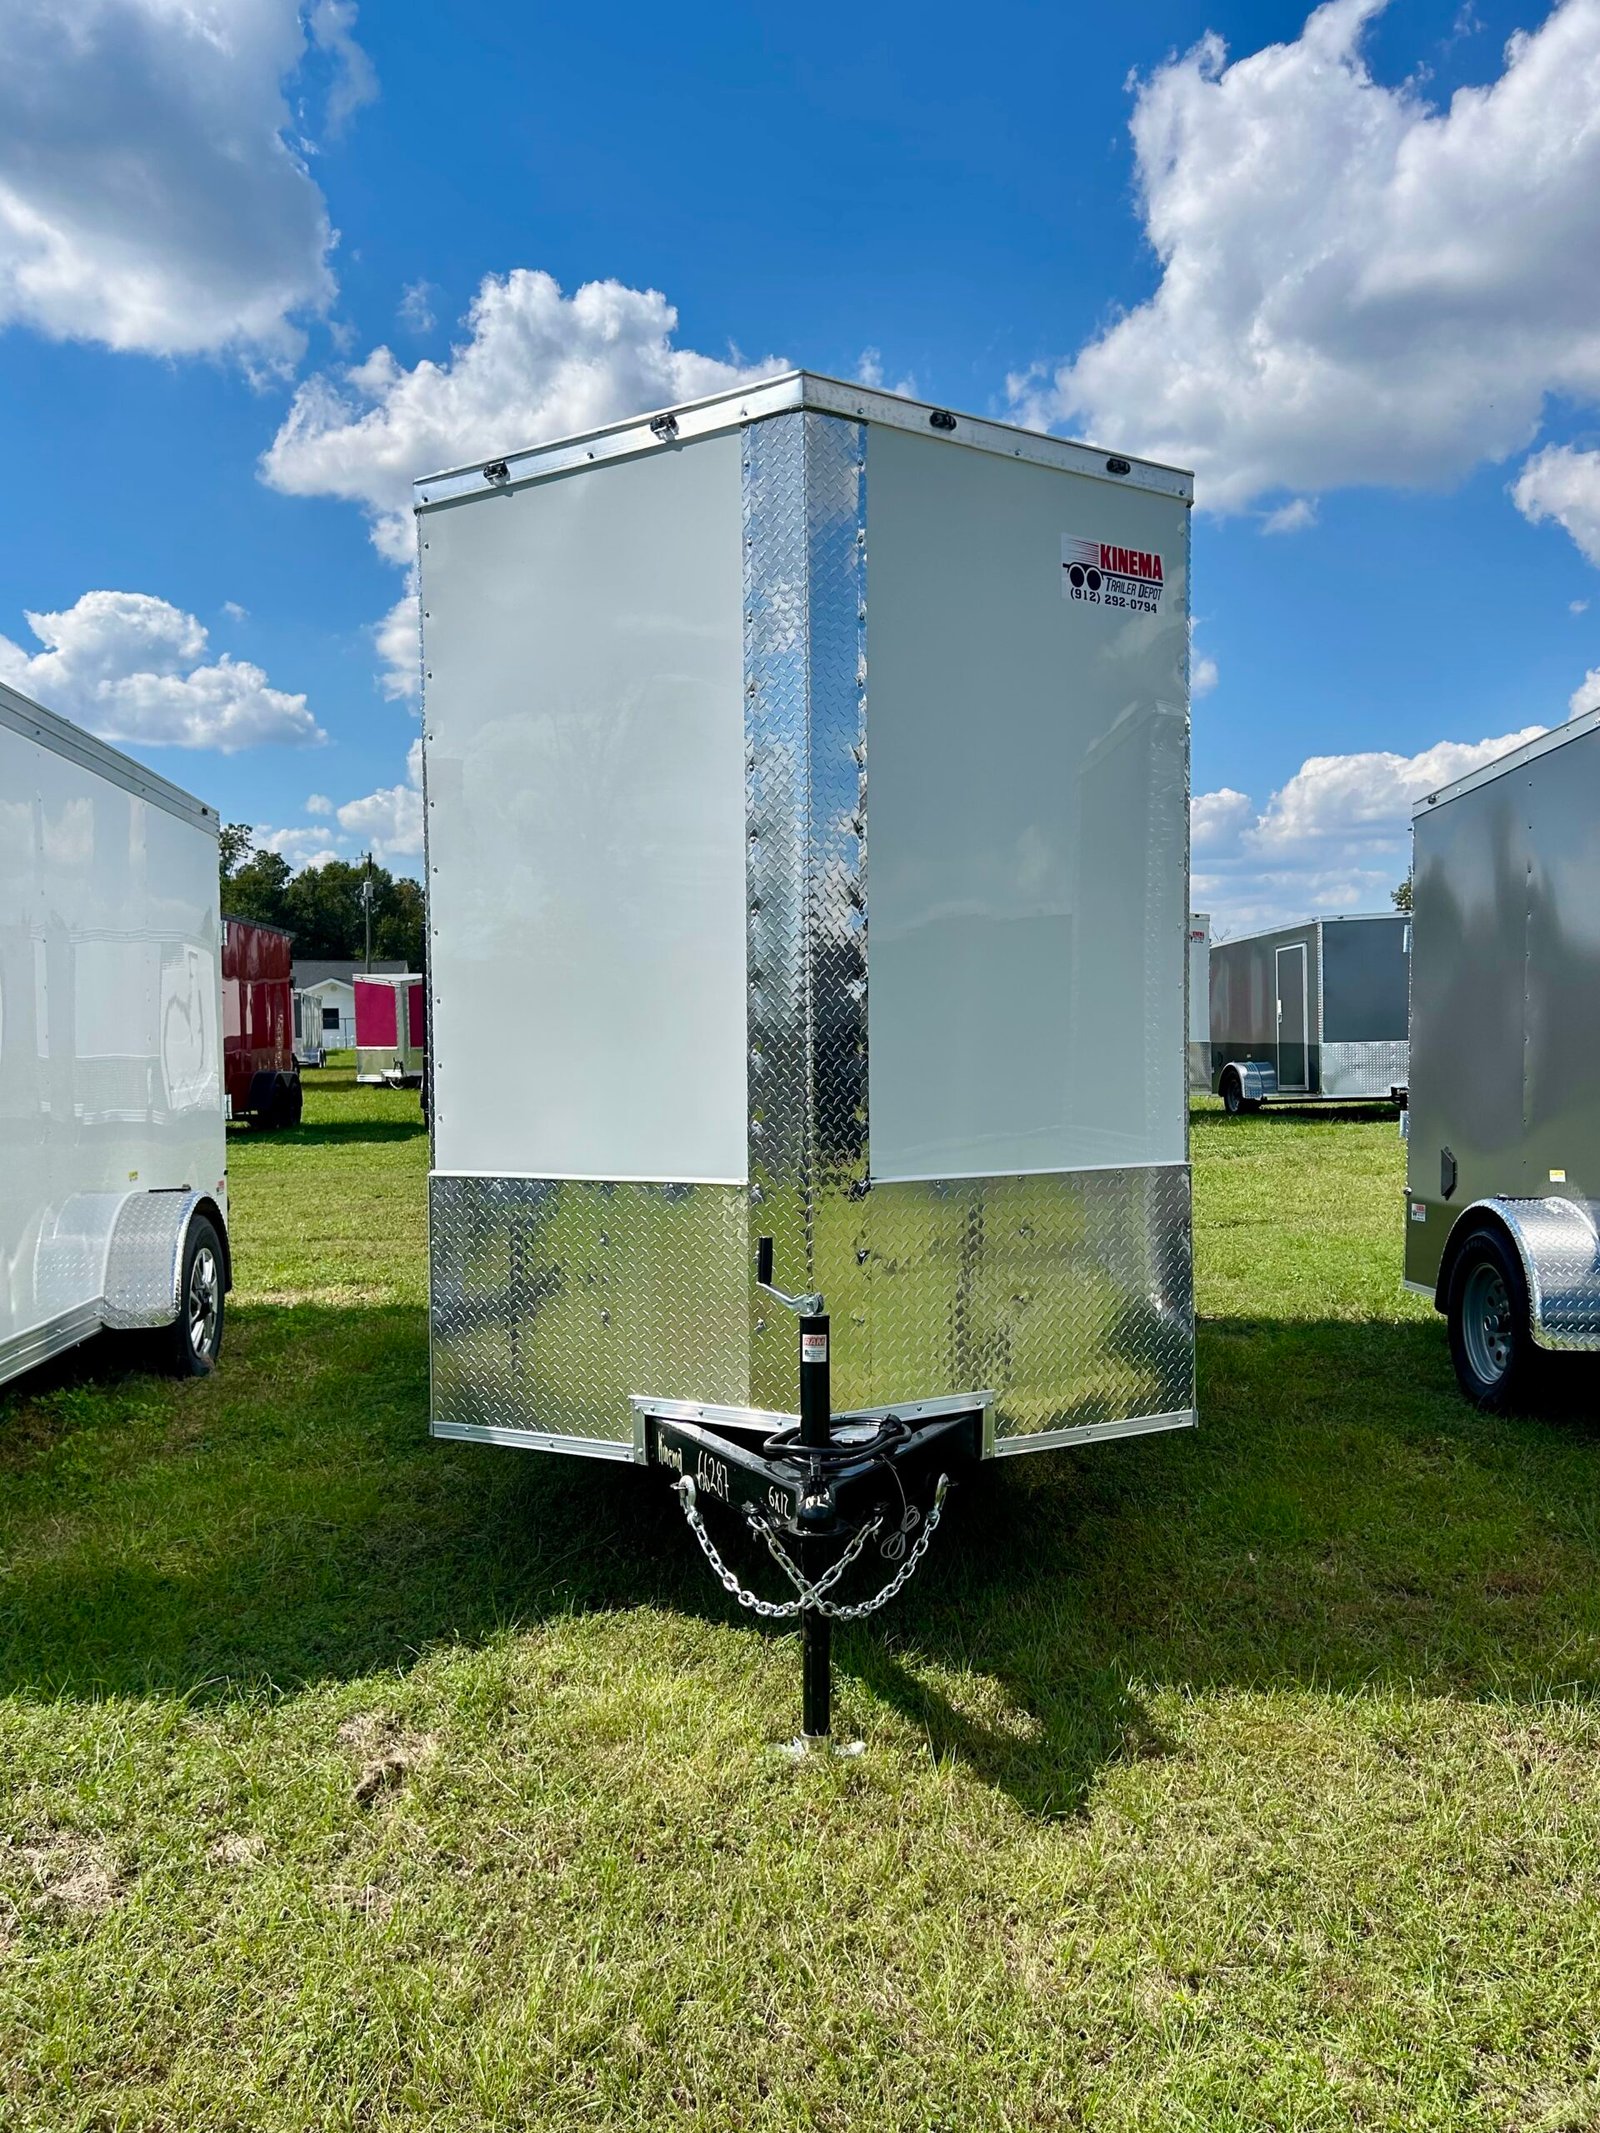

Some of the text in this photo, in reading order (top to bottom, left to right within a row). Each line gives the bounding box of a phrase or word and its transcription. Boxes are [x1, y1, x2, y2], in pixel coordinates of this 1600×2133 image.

[1100, 543, 1163, 581] KINEMA
[1070, 587, 1157, 613] (912) 292-0794
[1106, 577, 1162, 600] TRAILER DEPOT
[696, 1450, 729, 1503] 66287
